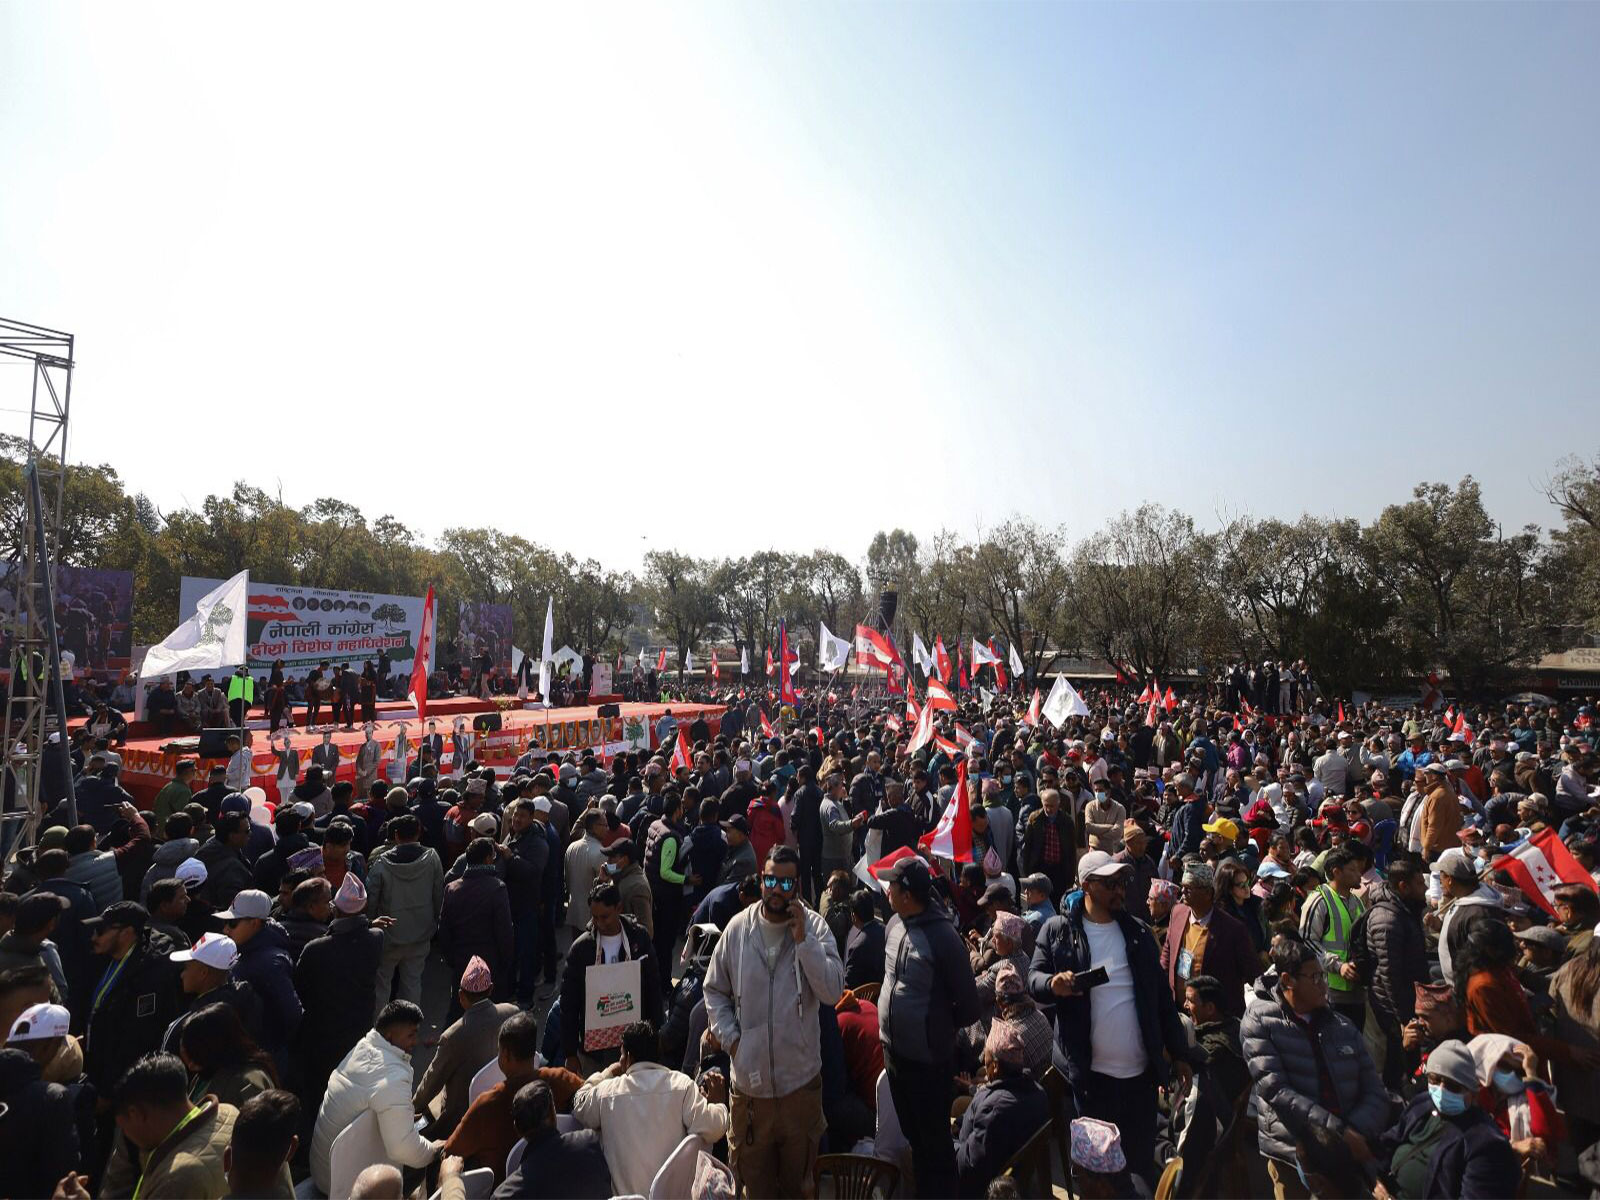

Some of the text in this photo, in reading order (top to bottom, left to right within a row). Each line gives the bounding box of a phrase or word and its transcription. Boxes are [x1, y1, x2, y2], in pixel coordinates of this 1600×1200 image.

[269, 619, 376, 638] नेपाली कांग्रेस
[251, 635, 406, 656] दोस्रो विशेष महाधिवेशन
